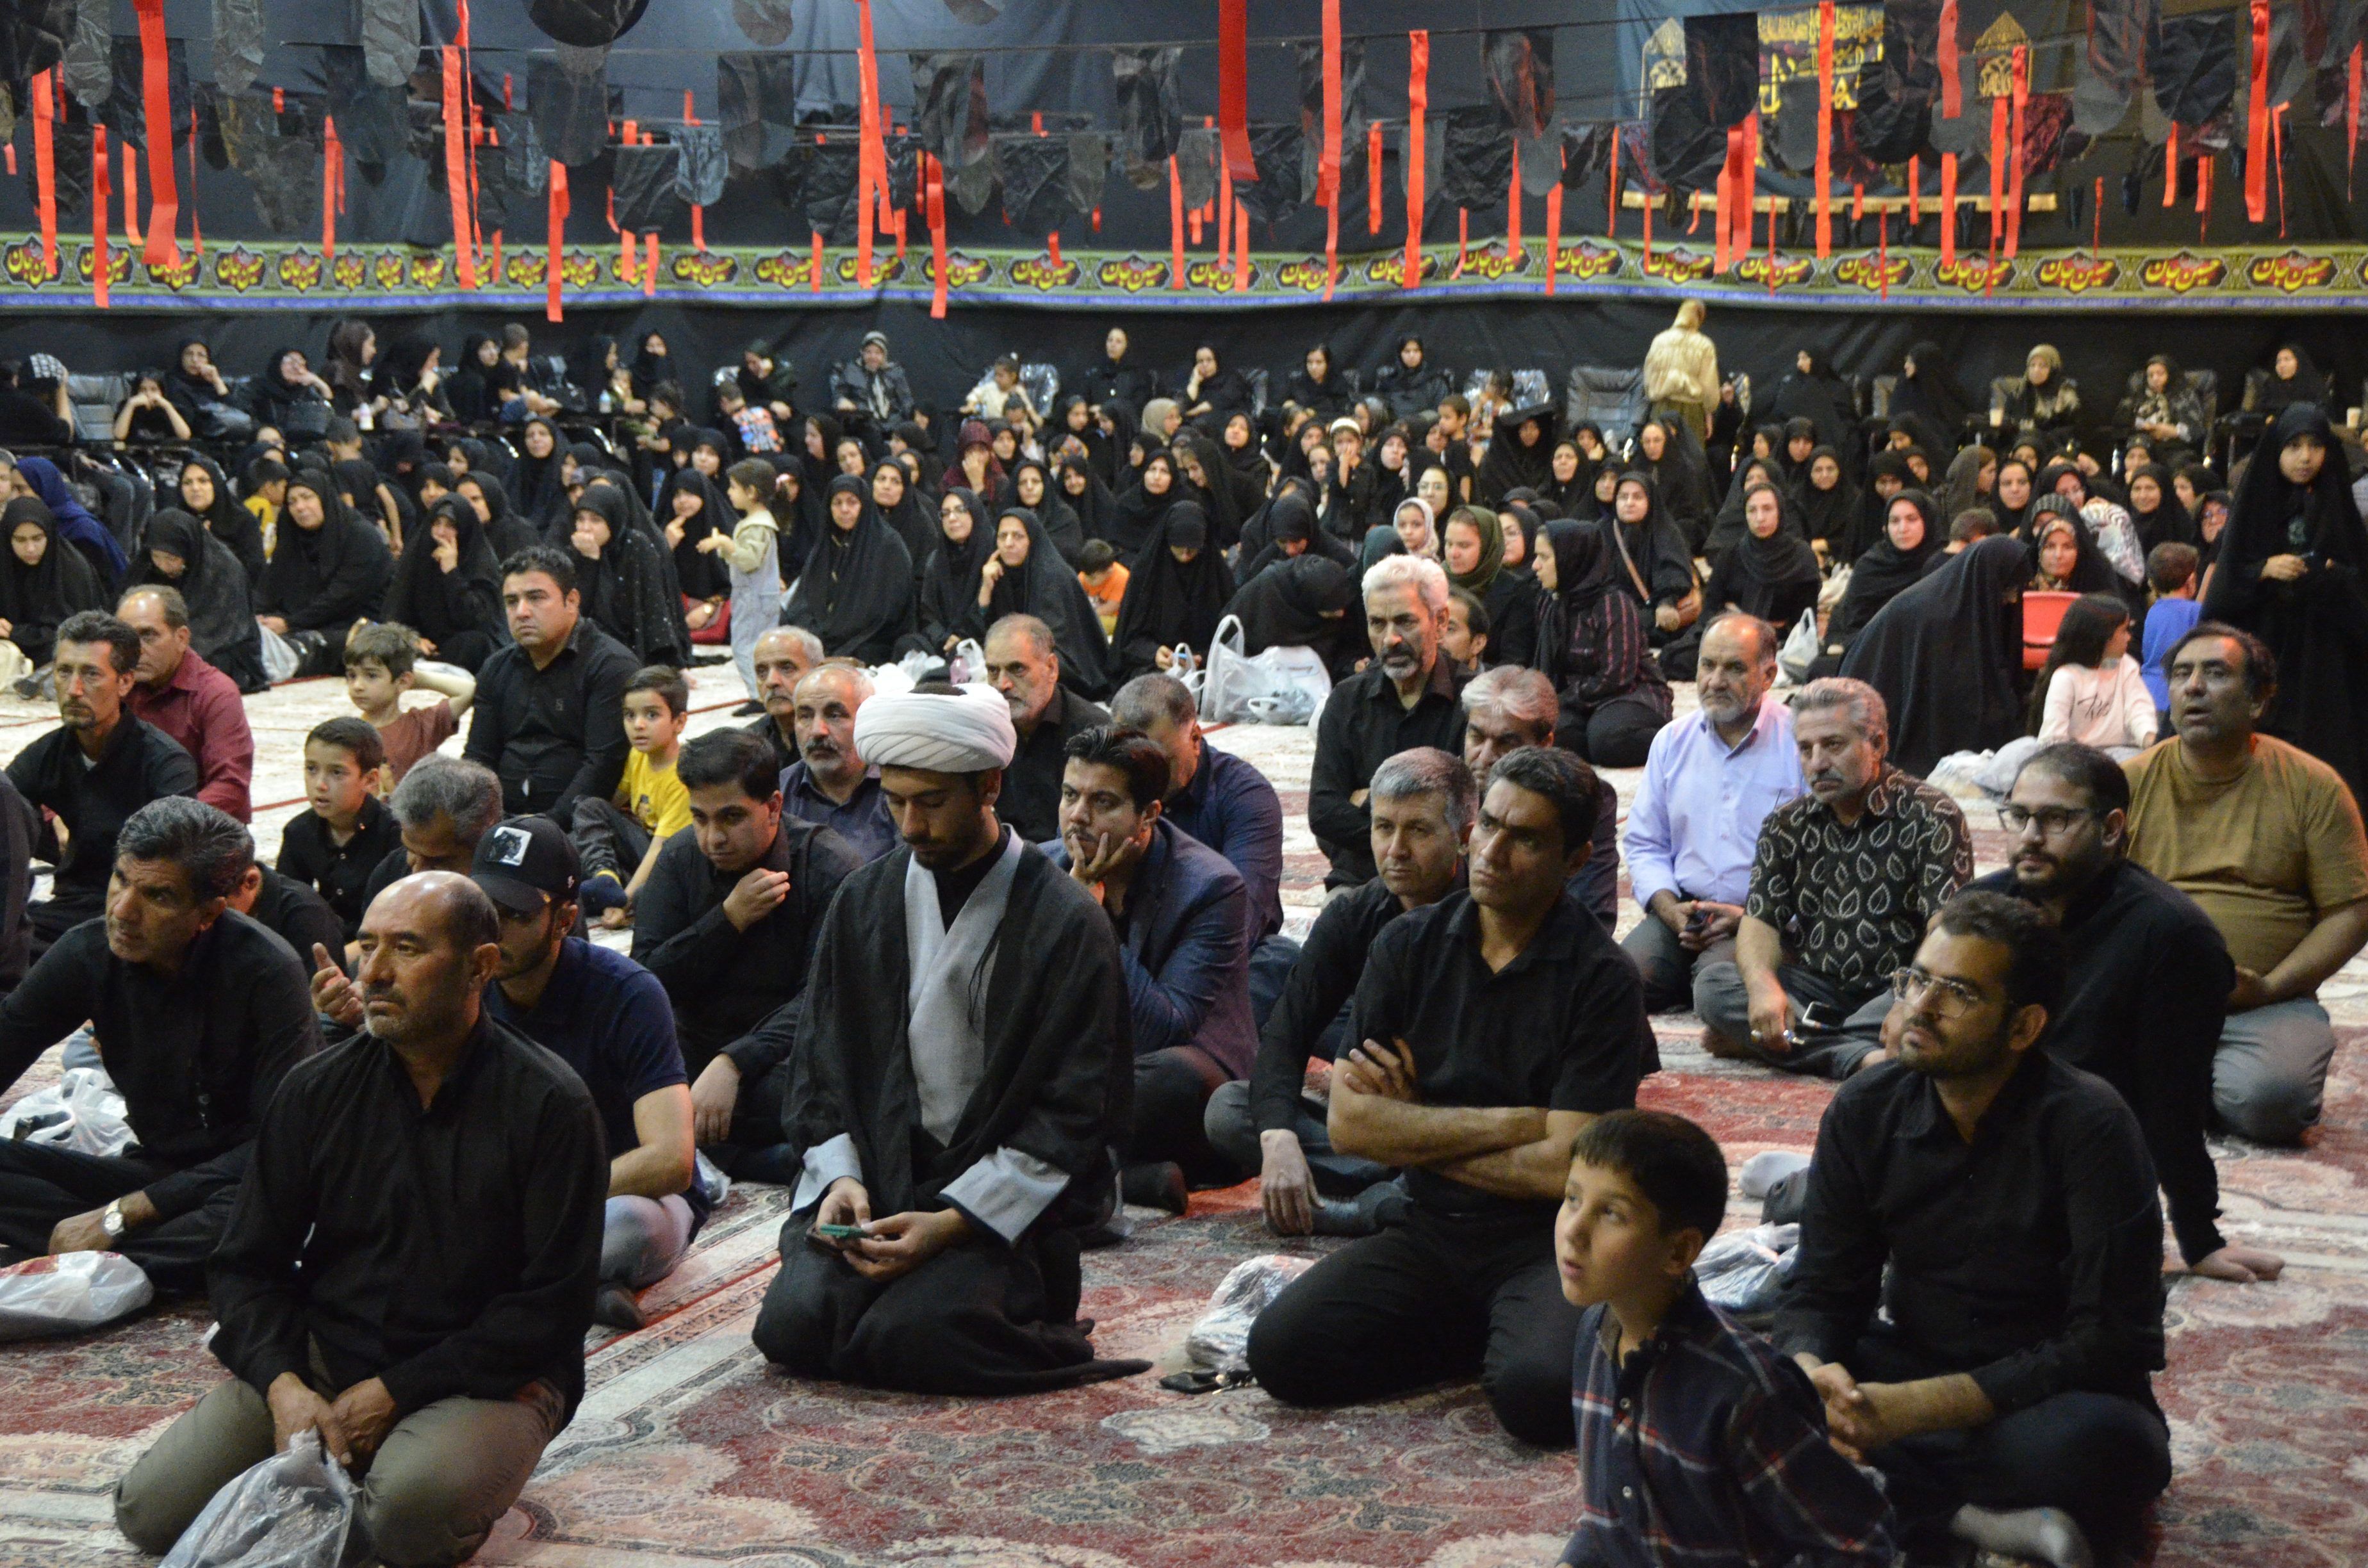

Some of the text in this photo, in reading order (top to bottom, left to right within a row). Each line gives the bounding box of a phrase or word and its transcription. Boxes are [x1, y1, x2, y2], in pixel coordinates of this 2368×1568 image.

[1101, 263, 1165, 291] حسین جان
[1555, 249, 1617, 279] حسین جان
[1673, 256, 1713, 284] حسین
[1838, 259, 1909, 290] حسین جان
[2040, 259, 2114, 293] حسین جان
[2144, 258, 2221, 293] حسین جان
[2253, 258, 2290, 288] جان
[2284, 258, 2331, 293] حسین
